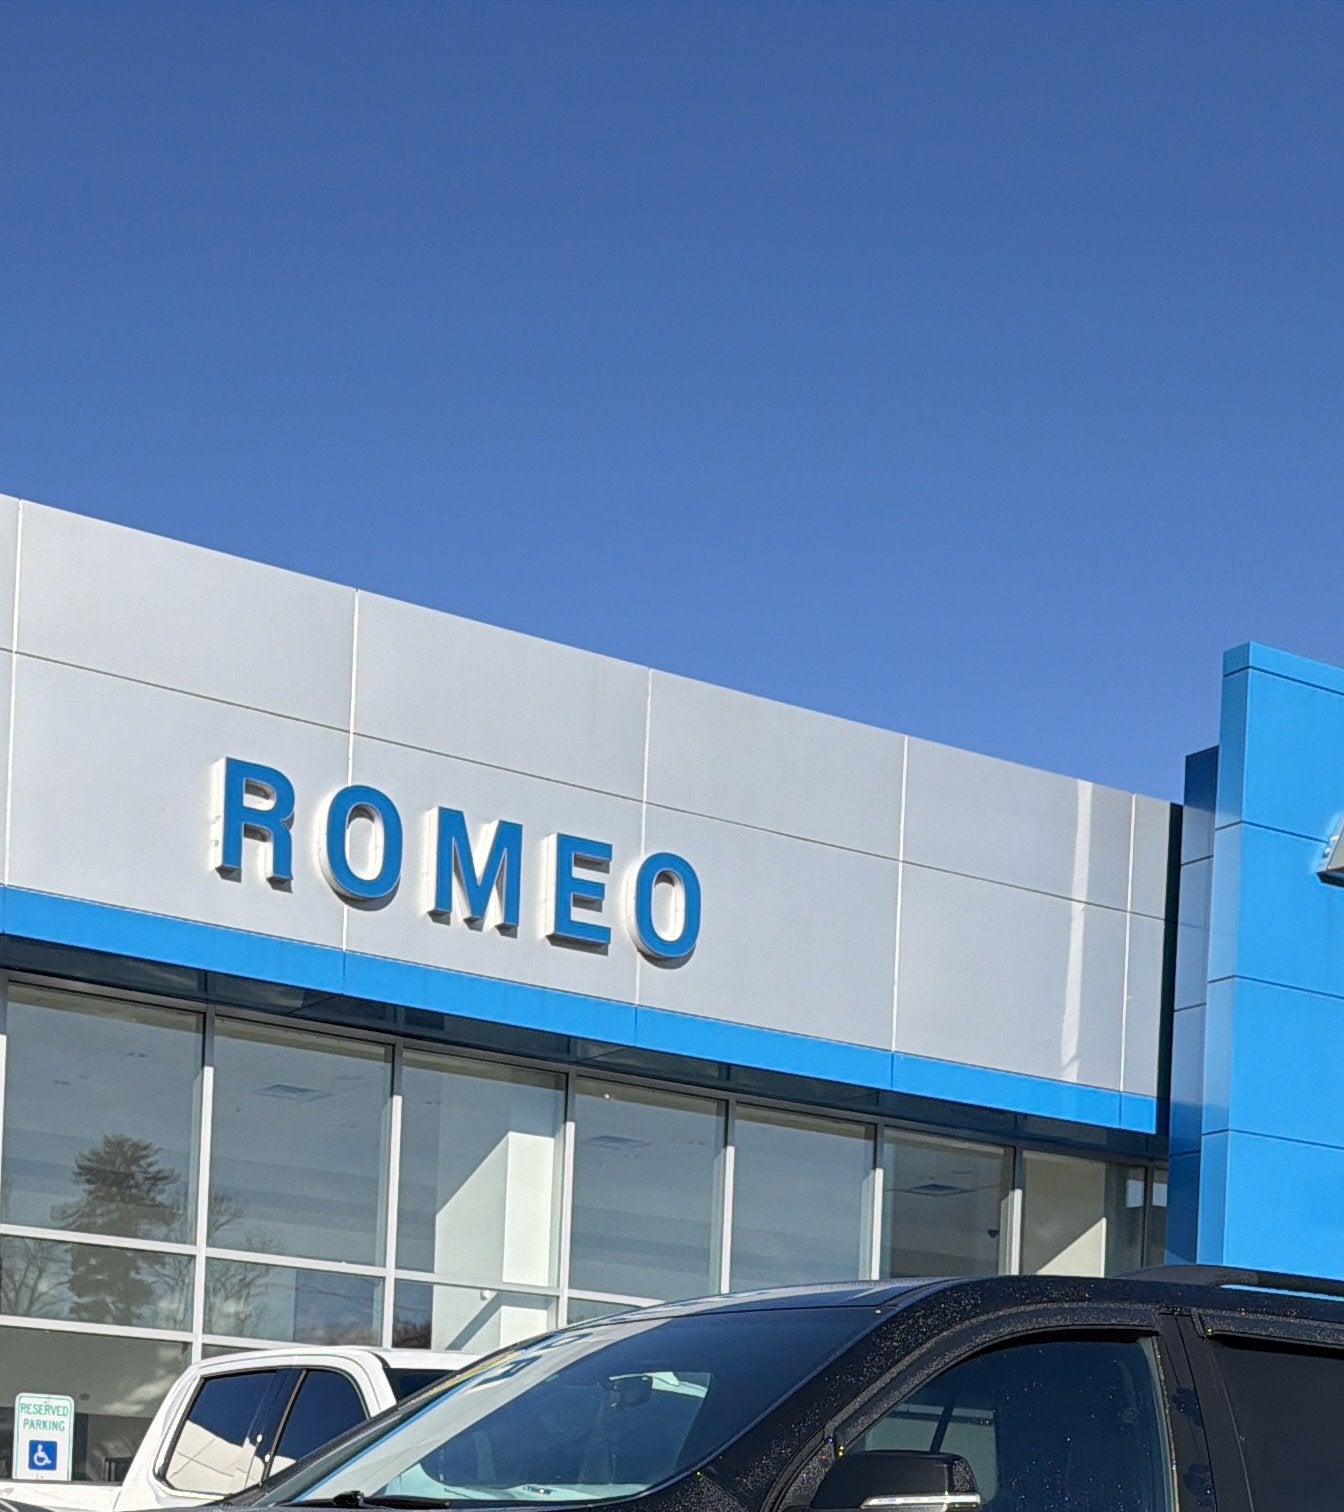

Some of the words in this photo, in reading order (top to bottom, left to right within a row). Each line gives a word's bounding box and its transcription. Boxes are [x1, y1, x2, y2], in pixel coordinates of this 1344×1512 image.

[211, 757, 702, 966] ROMEO
[20, 1403, 69, 1417] RESERVED
[23, 1418, 65, 1432] PARKING
